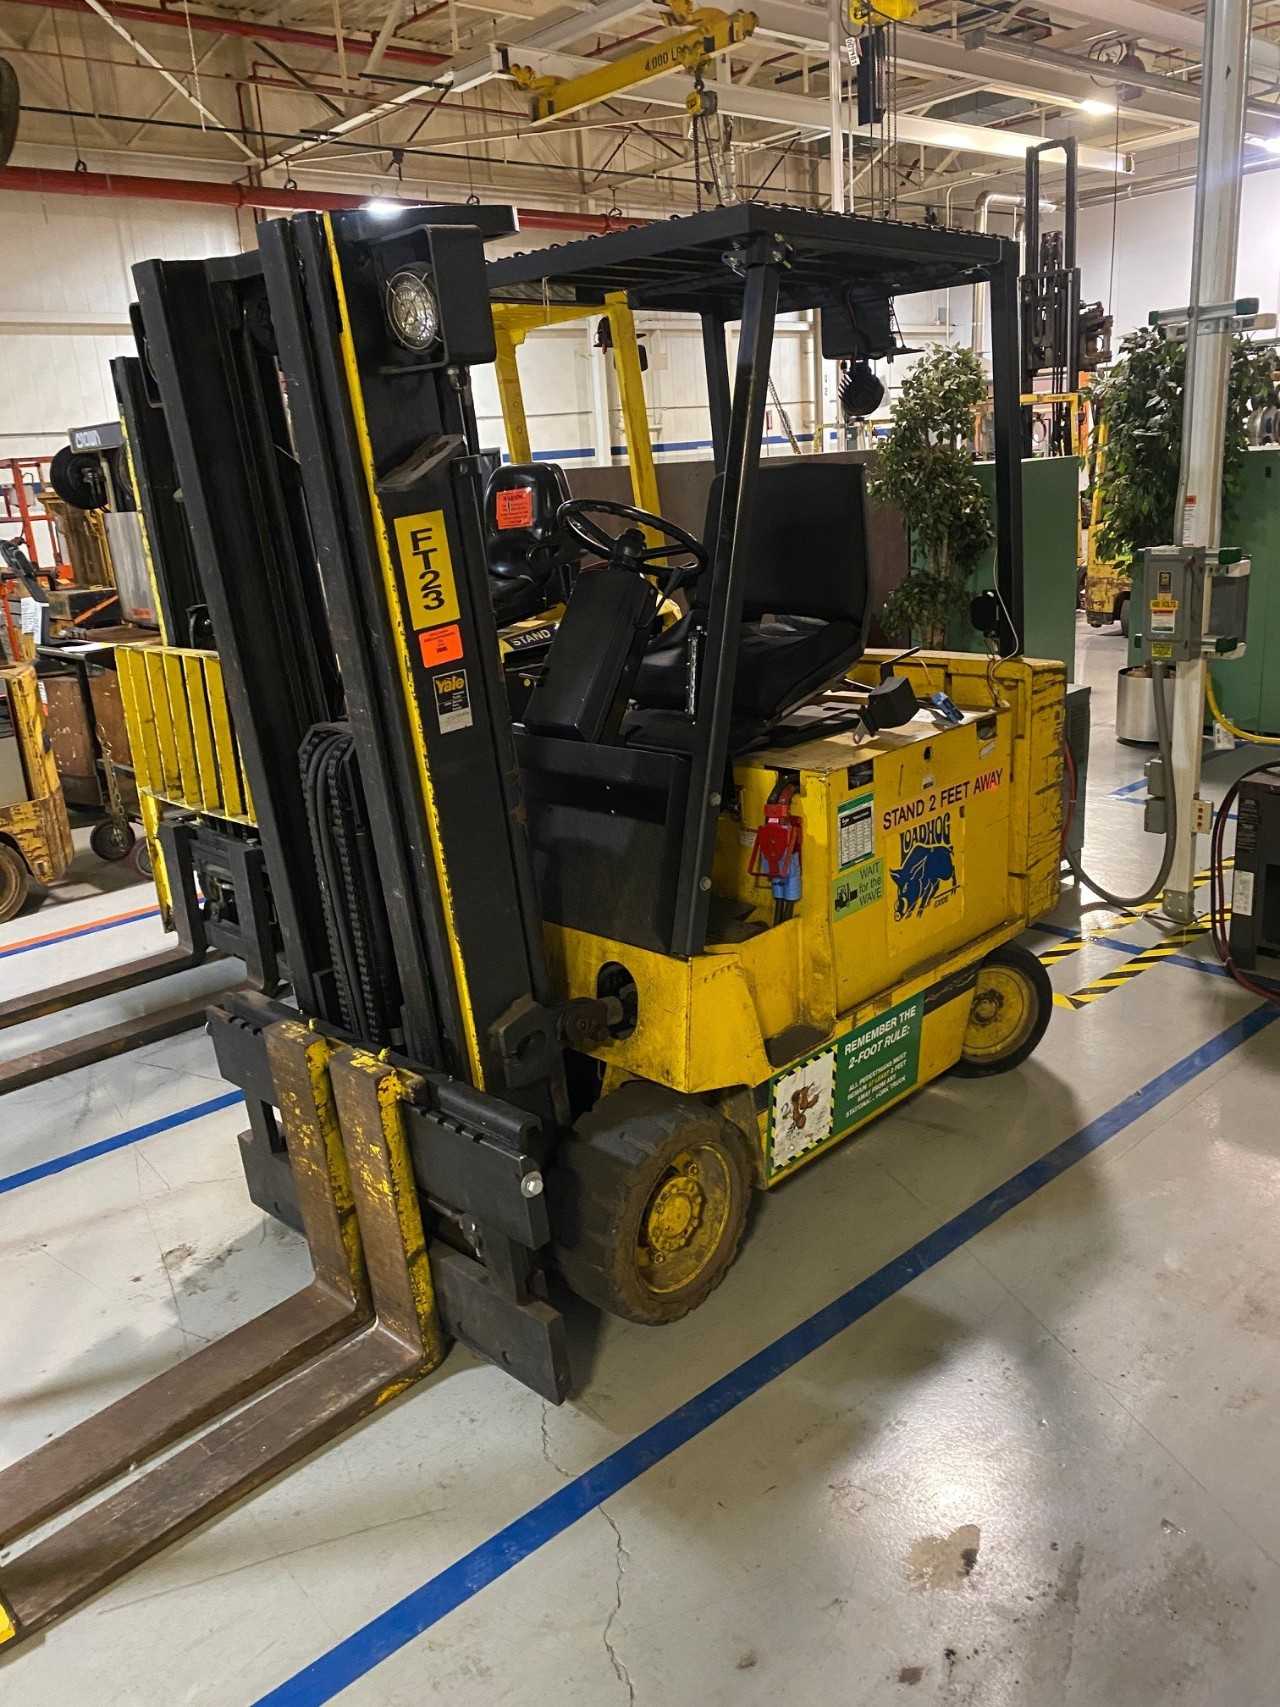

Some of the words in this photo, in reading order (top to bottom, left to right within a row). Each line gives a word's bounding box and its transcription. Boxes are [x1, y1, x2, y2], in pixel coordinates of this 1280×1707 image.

[511, 629, 551, 646] STAND
[435, 676, 465, 694] Yale
[883, 799, 925, 830] STAND
[928, 794, 937, 812] 2
[941, 780, 970, 808] FEET
[973, 768, 1003, 795] AWAY
[900, 812, 952, 864] LOADHOG
[860, 862, 880, 879] WAIT
[858, 882, 869, 894] for
[871, 875, 881, 889] the
[859, 888, 881, 906] WAVE
[845, 1017, 897, 1056] REMEMBER
[898, 1005, 917, 1023] THE
[848, 1040, 884, 1069] 2-FOOT
[884, 1025, 911, 1047] RULE:
